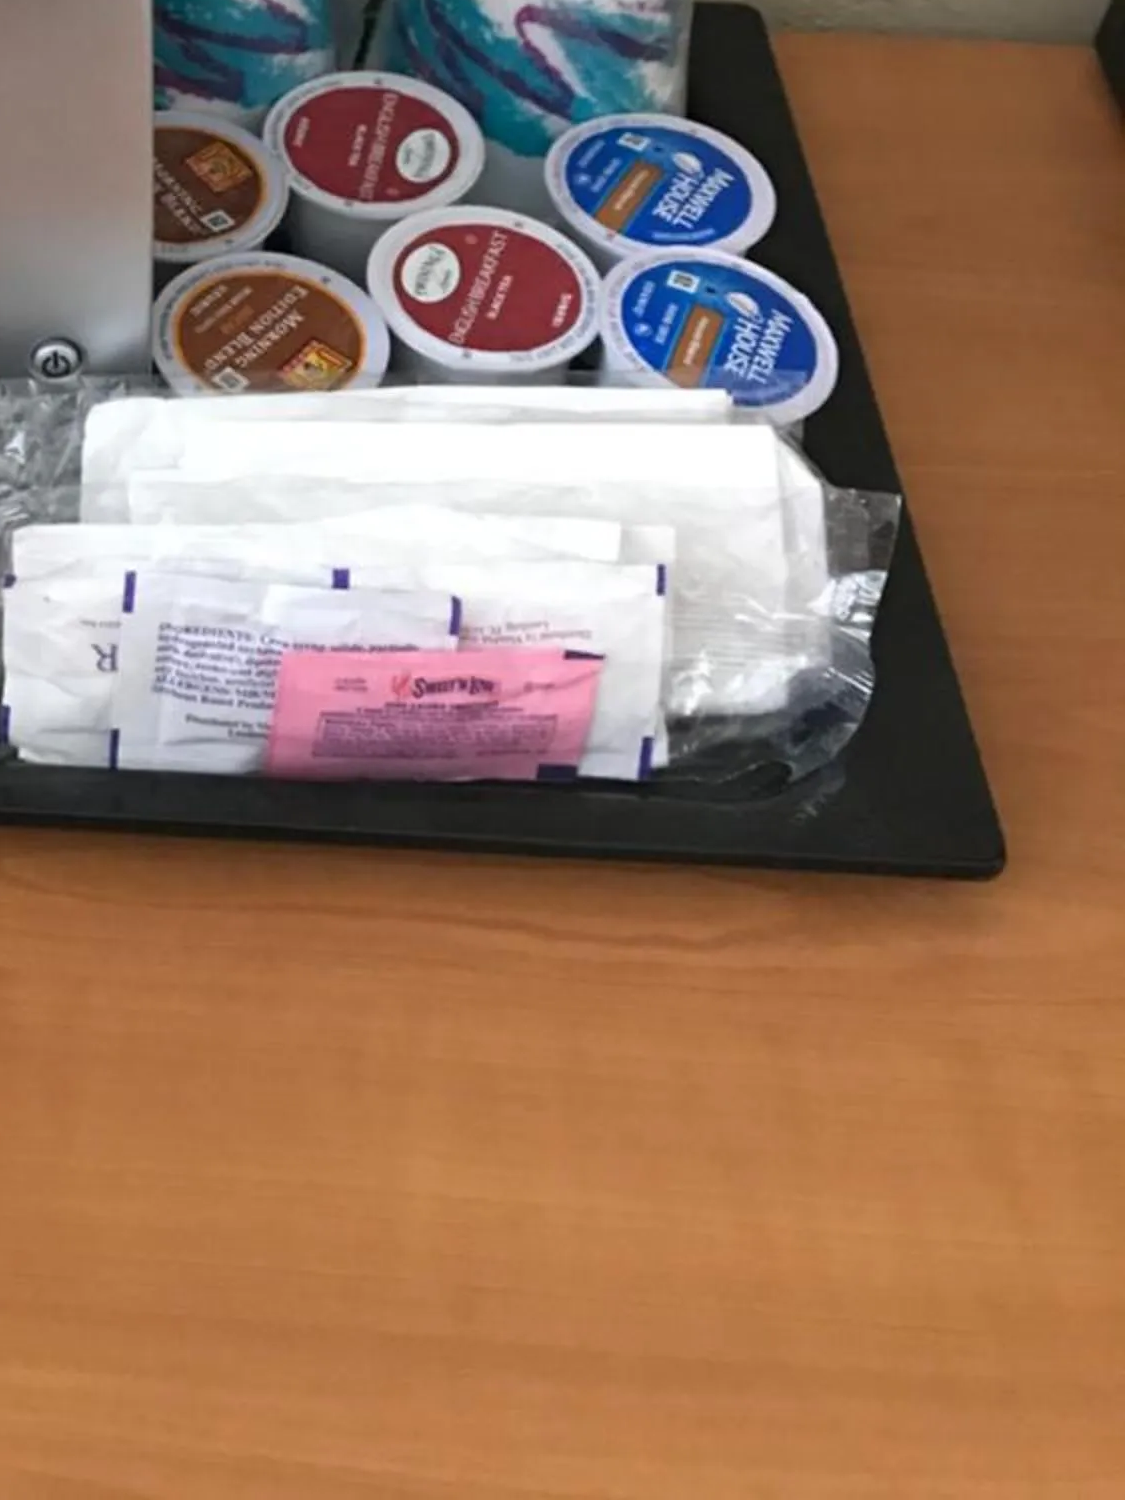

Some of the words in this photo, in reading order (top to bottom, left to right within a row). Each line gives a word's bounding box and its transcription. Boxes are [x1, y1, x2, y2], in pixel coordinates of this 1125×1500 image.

[652, 171, 697, 223] HOUSE
[673, 167, 736, 229] MAXWELL
[234, 308, 307, 369] MORNING
[249, 284, 309, 335] EDITION
[724, 318, 763, 377] HOUSE
[747, 308, 793, 384] MAXWELL
